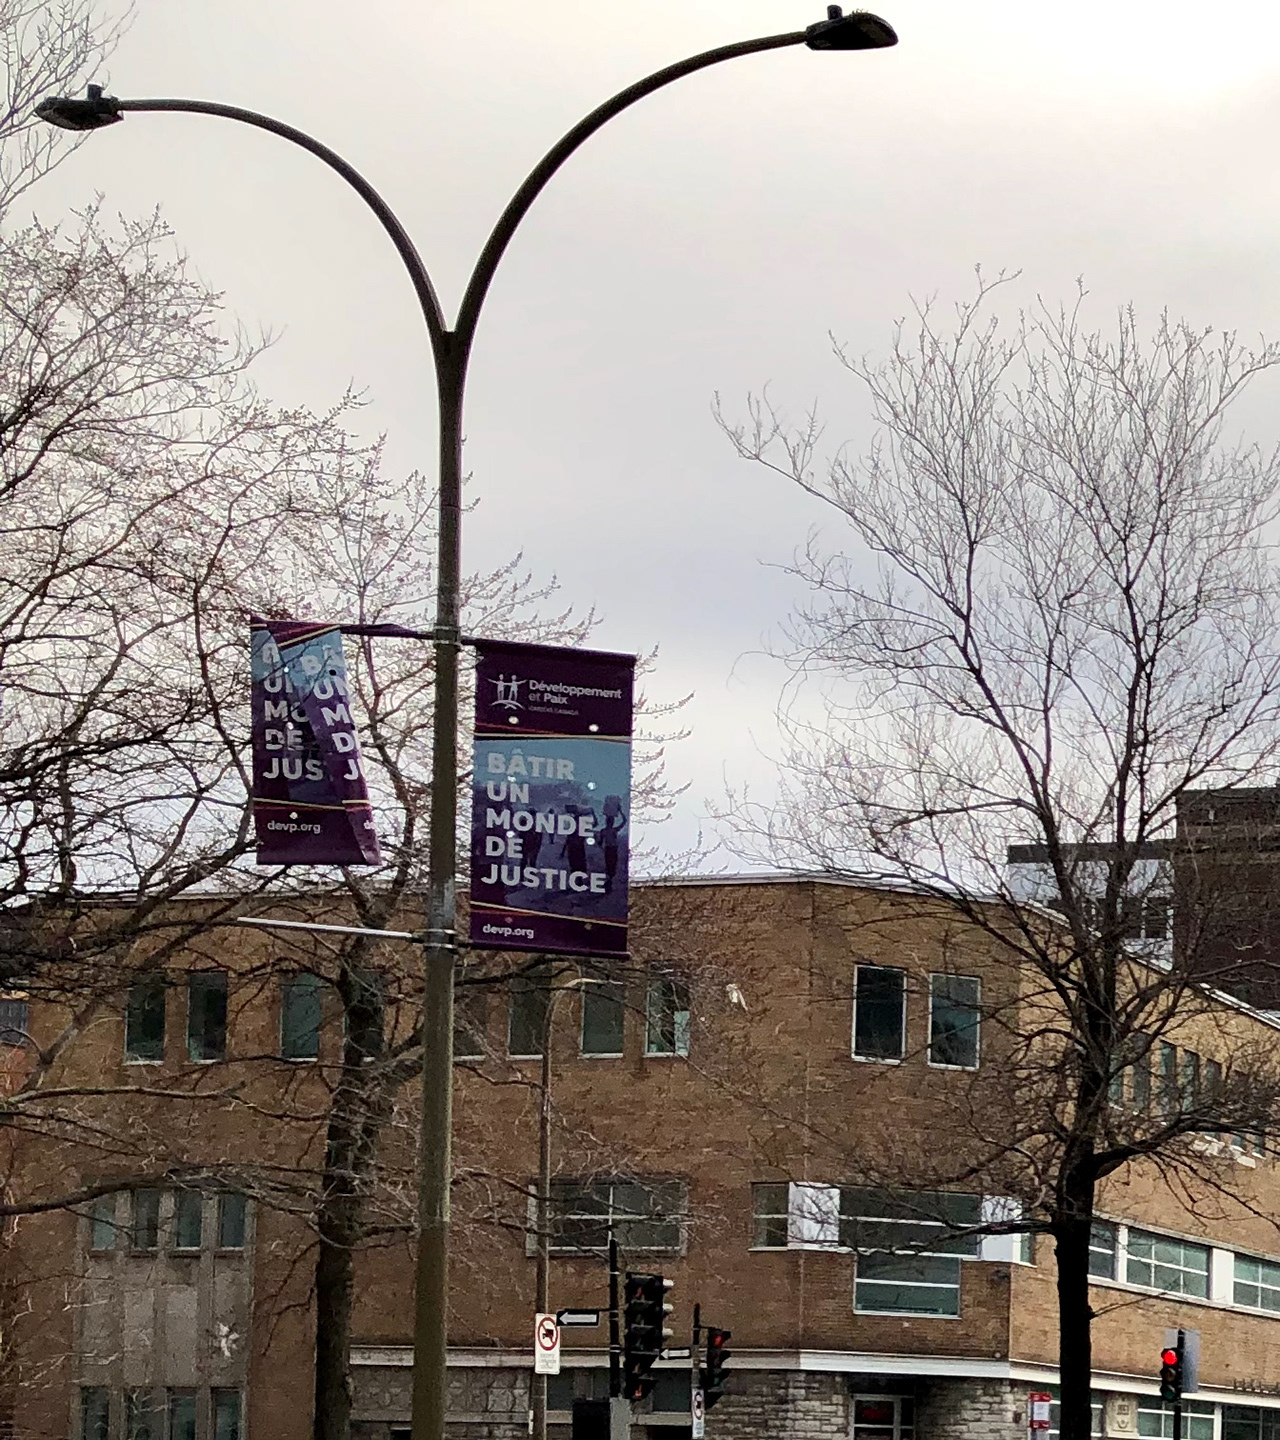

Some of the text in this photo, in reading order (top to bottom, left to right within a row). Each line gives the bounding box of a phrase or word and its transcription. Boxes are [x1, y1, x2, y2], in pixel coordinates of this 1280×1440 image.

[528, 693, 569, 705] et Paix
[529, 680, 622, 699] Développement
[487, 748, 576, 781] BÂTIR
[486, 780, 530, 804] UN
[267, 820, 321, 835] devp.org
[485, 808, 595, 837] MONDE
[485, 836, 524, 859] DE
[480, 863, 607, 894] JUSTICE
[482, 923, 535, 939] devp.org
